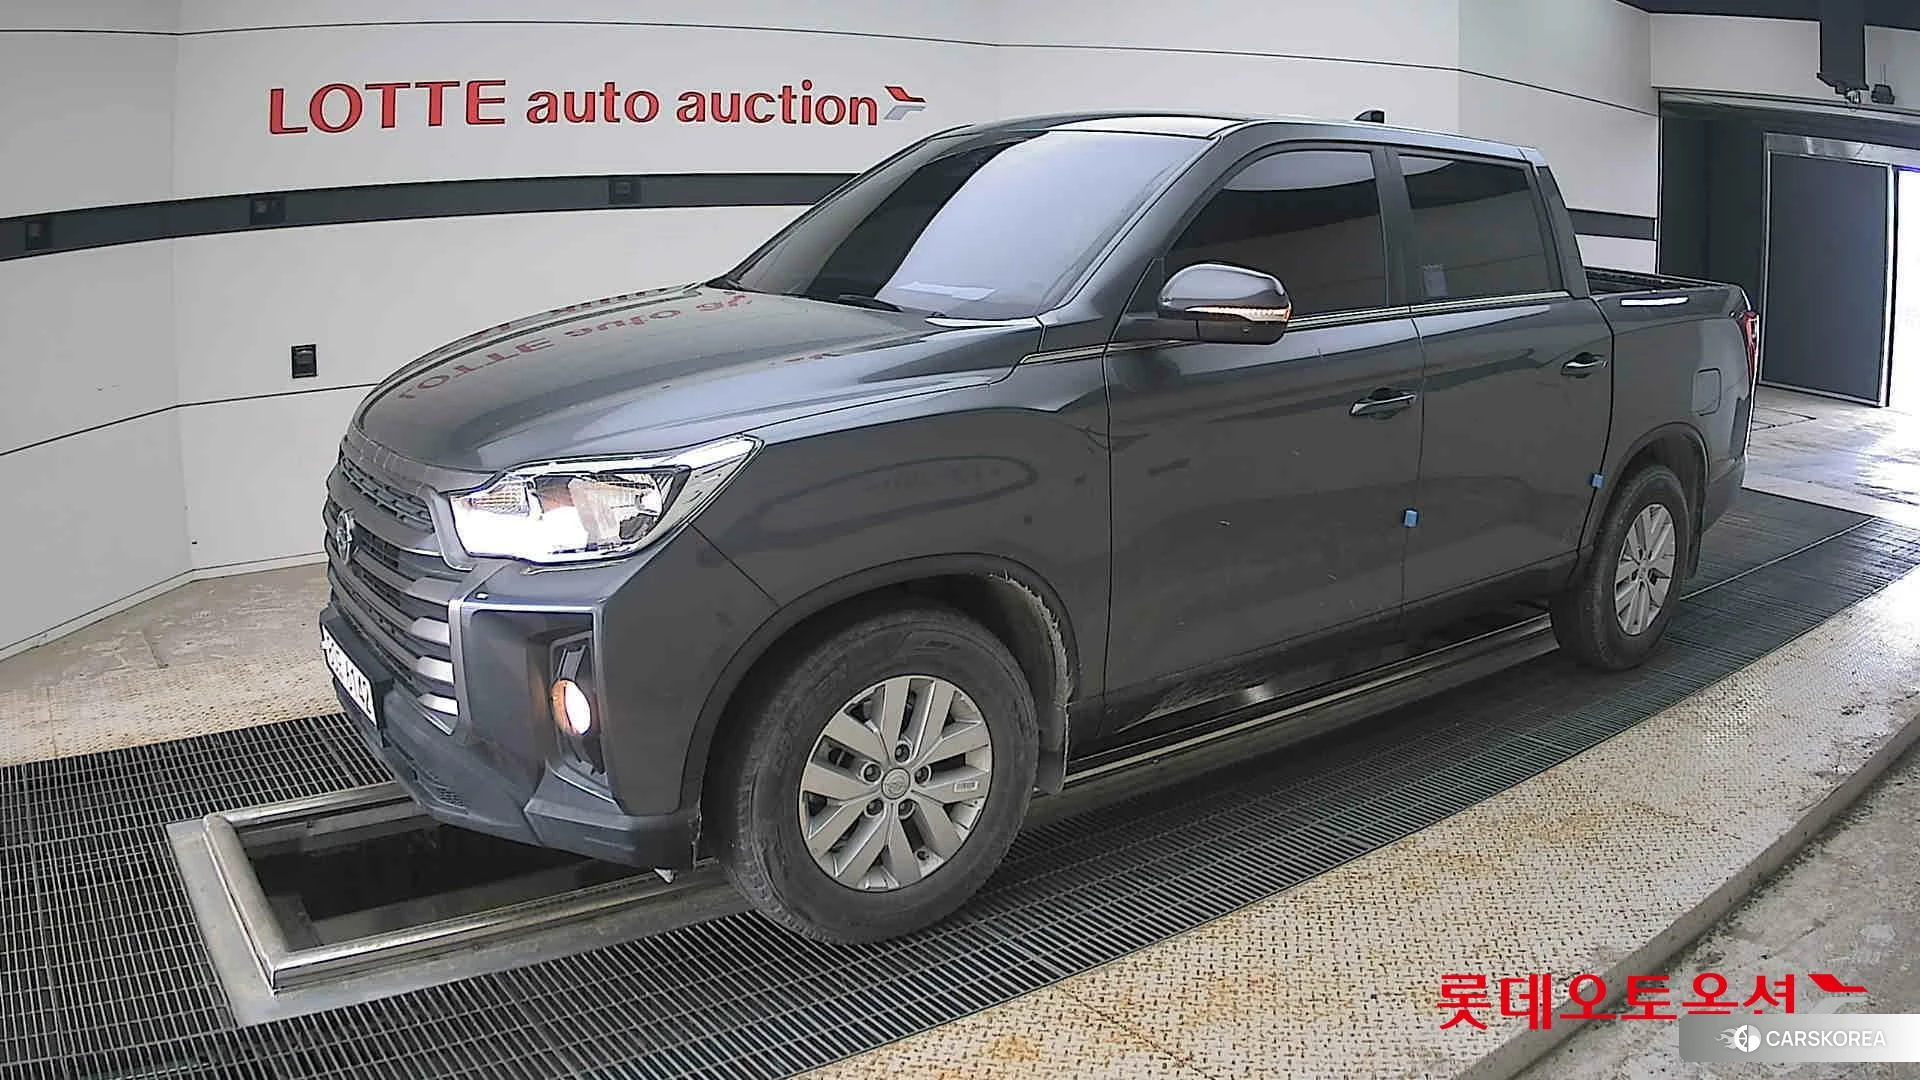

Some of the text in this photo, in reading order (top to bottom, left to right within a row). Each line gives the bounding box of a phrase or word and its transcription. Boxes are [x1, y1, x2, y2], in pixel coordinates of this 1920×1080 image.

[269, 79, 879, 135] LOTTE auto auction
